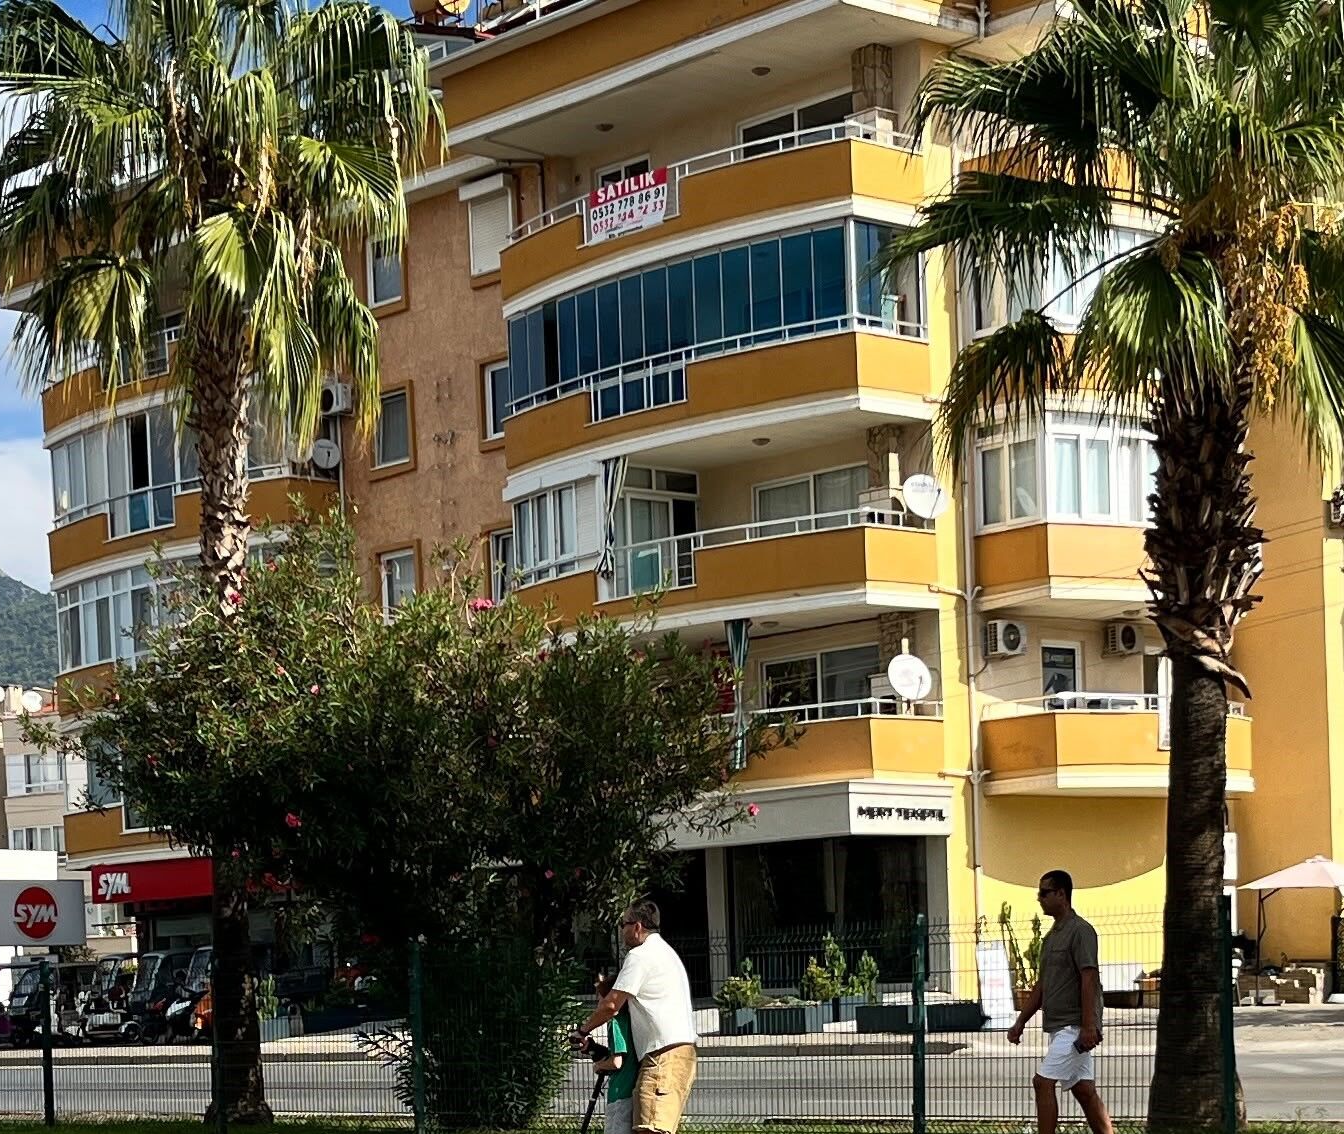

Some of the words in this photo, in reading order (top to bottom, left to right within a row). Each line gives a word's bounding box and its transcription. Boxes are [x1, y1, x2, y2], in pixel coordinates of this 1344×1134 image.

[597, 170, 655, 203] SATILIK
[592, 203, 615, 220] 0532
[618, 196, 635, 211] 778
[638, 190, 651, 204] 86
[653, 186, 665, 199] 91
[98, 872, 132, 901] SYM
[14, 904, 58, 929] SYM
